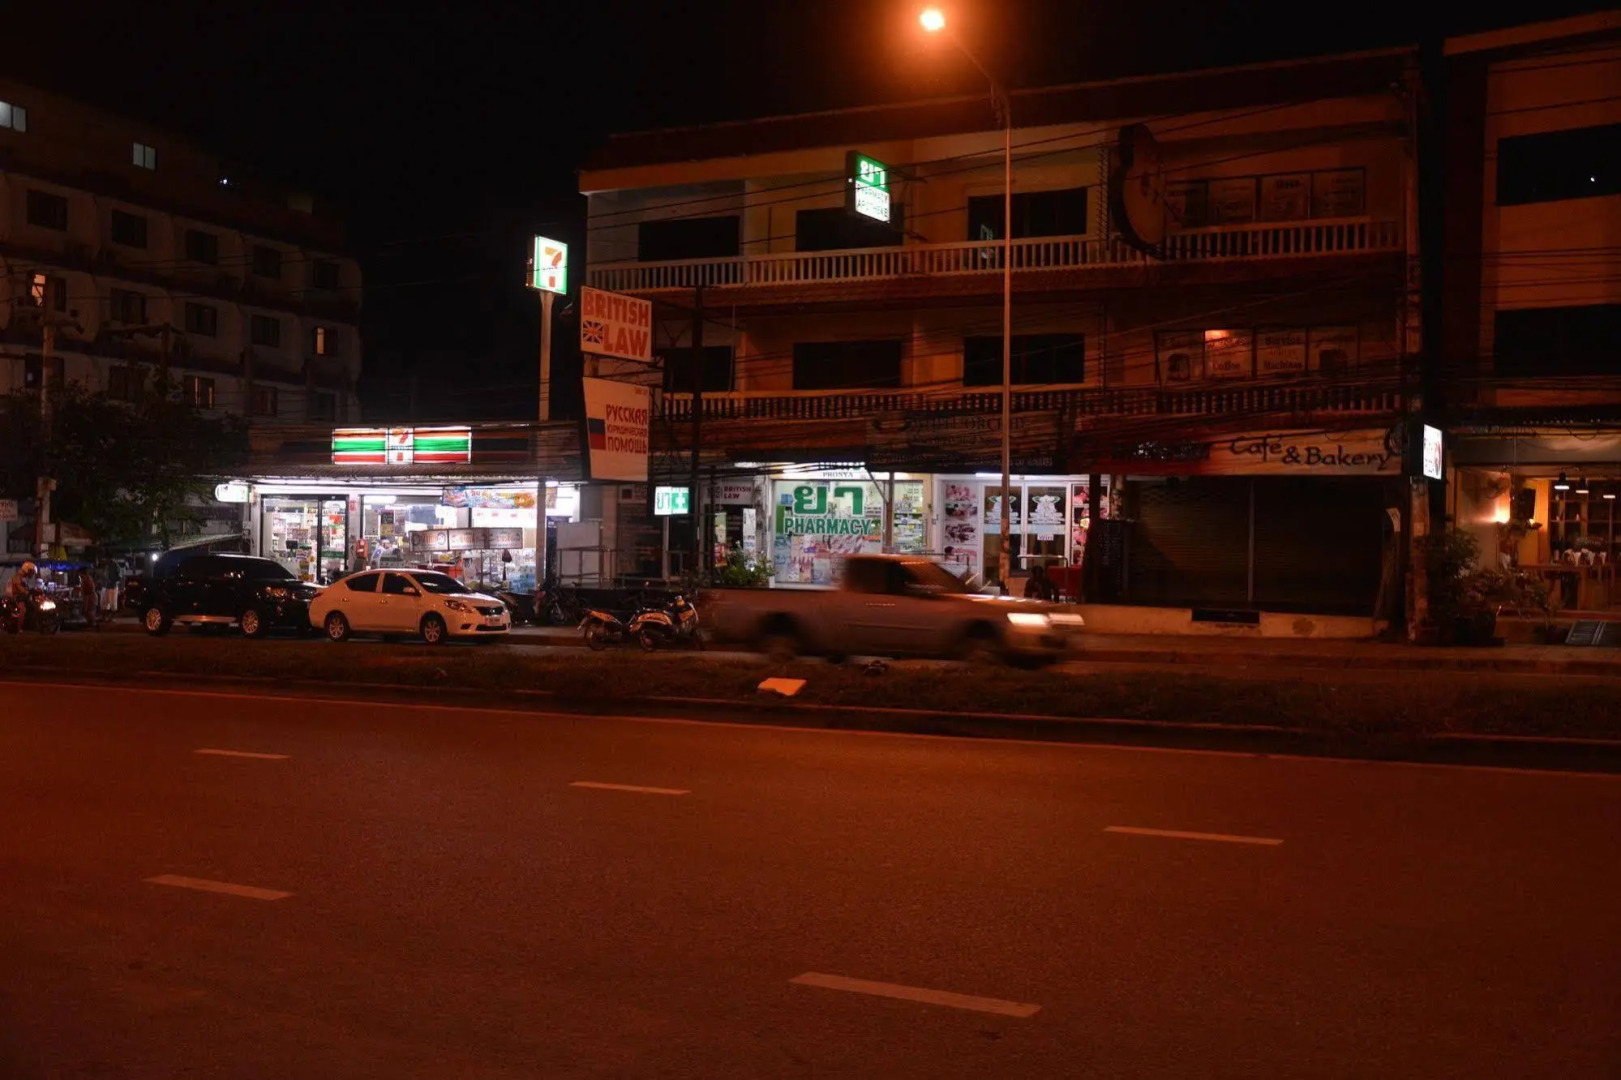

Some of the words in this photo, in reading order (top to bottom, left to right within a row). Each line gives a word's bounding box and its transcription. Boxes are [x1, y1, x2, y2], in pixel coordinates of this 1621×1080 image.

[860, 160, 885, 188] ยา
[584, 292, 649, 327] BRITISH
[603, 323, 648, 357] LAW
[605, 404, 648, 425] РУССКАЯ
[607, 437, 647, 454] ПОМОЩЬ
[1282, 446, 1299, 465] &
[1305, 446, 1388, 471] Bakery
[794, 486, 864, 515] ยา
[785, 519, 871, 535] PHARMACY
